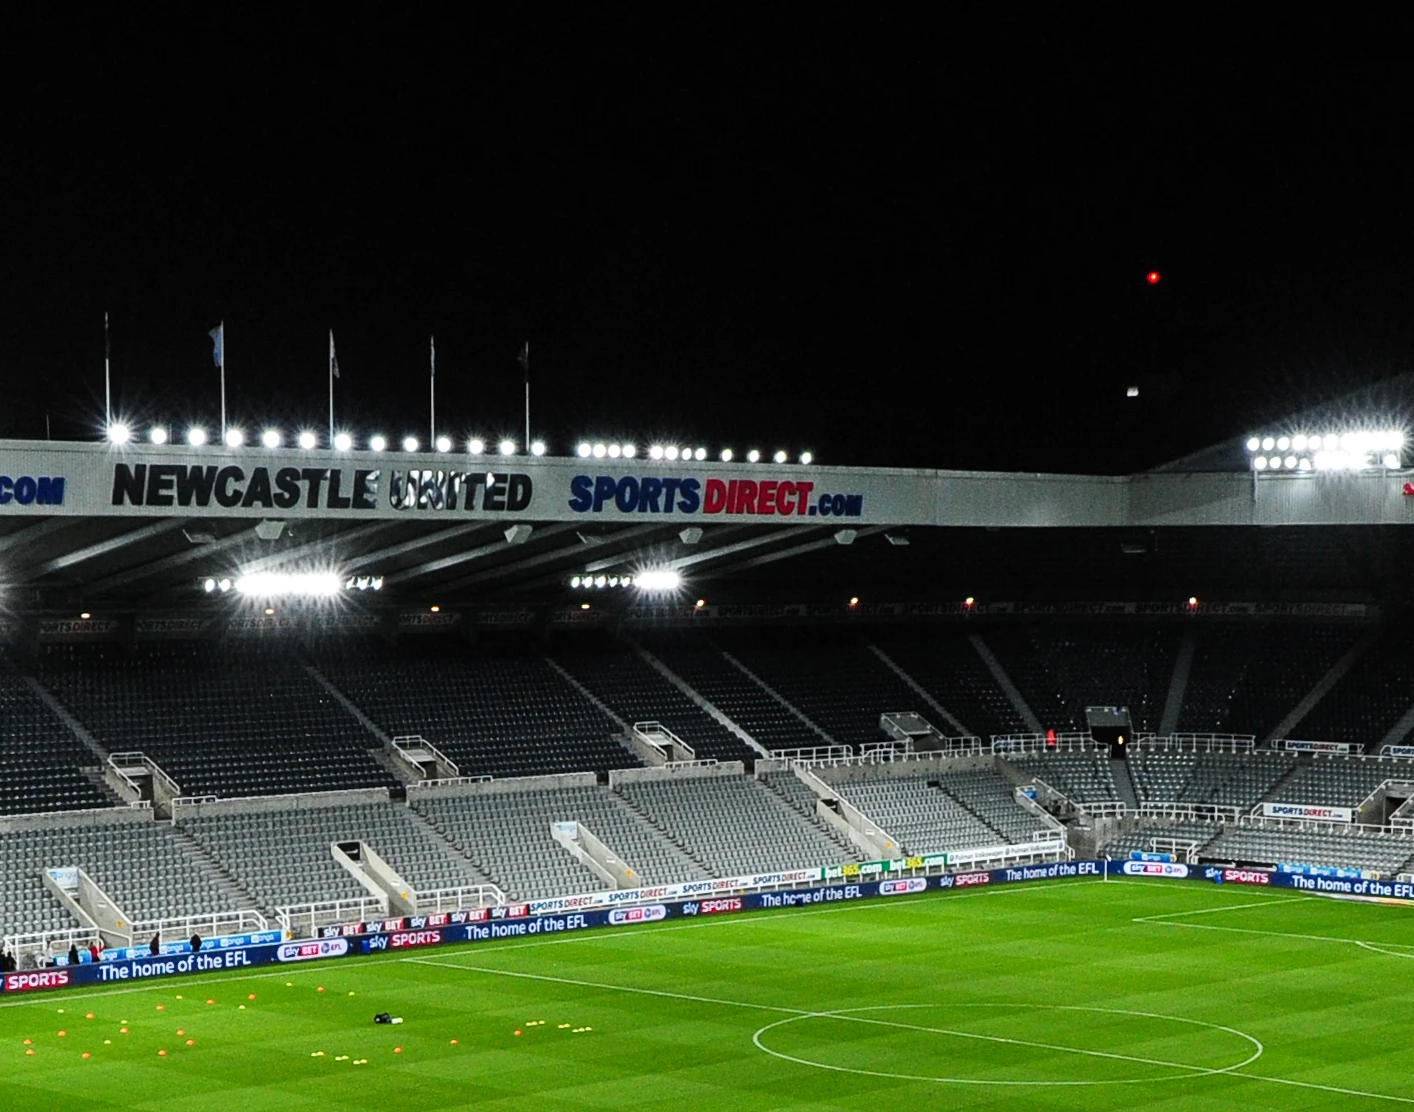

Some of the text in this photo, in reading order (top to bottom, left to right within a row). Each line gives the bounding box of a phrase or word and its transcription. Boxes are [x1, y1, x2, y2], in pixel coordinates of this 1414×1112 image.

[111, 464, 533, 511] NEWCASTLE UNITED
[568, 475, 862, 516] SPORTSDIRECT.COM
[940, 873, 989, 889] sky SPORTS
[1007, 861, 1099, 881] The home of the EFL
[1225, 869, 1268, 883] SPORTS
[1293, 875, 1315, 889] The
[1317, 876, 1351, 892] home
[1355, 879, 1370, 894] of
[1370, 880, 1391, 896] the
[762, 893, 786, 907] The
[810, 887, 824, 901] of
[825, 887, 843, 900] the
[845, 885, 862, 898] EFL
[683, 898, 741, 915] sky SPORTS
[466, 914, 587, 940] The home of the EFL
[369, 931, 440, 949] sky SPORTS
[99, 950, 251, 980] The home of the EFL
[8, 971, 68, 989] SPORTS
